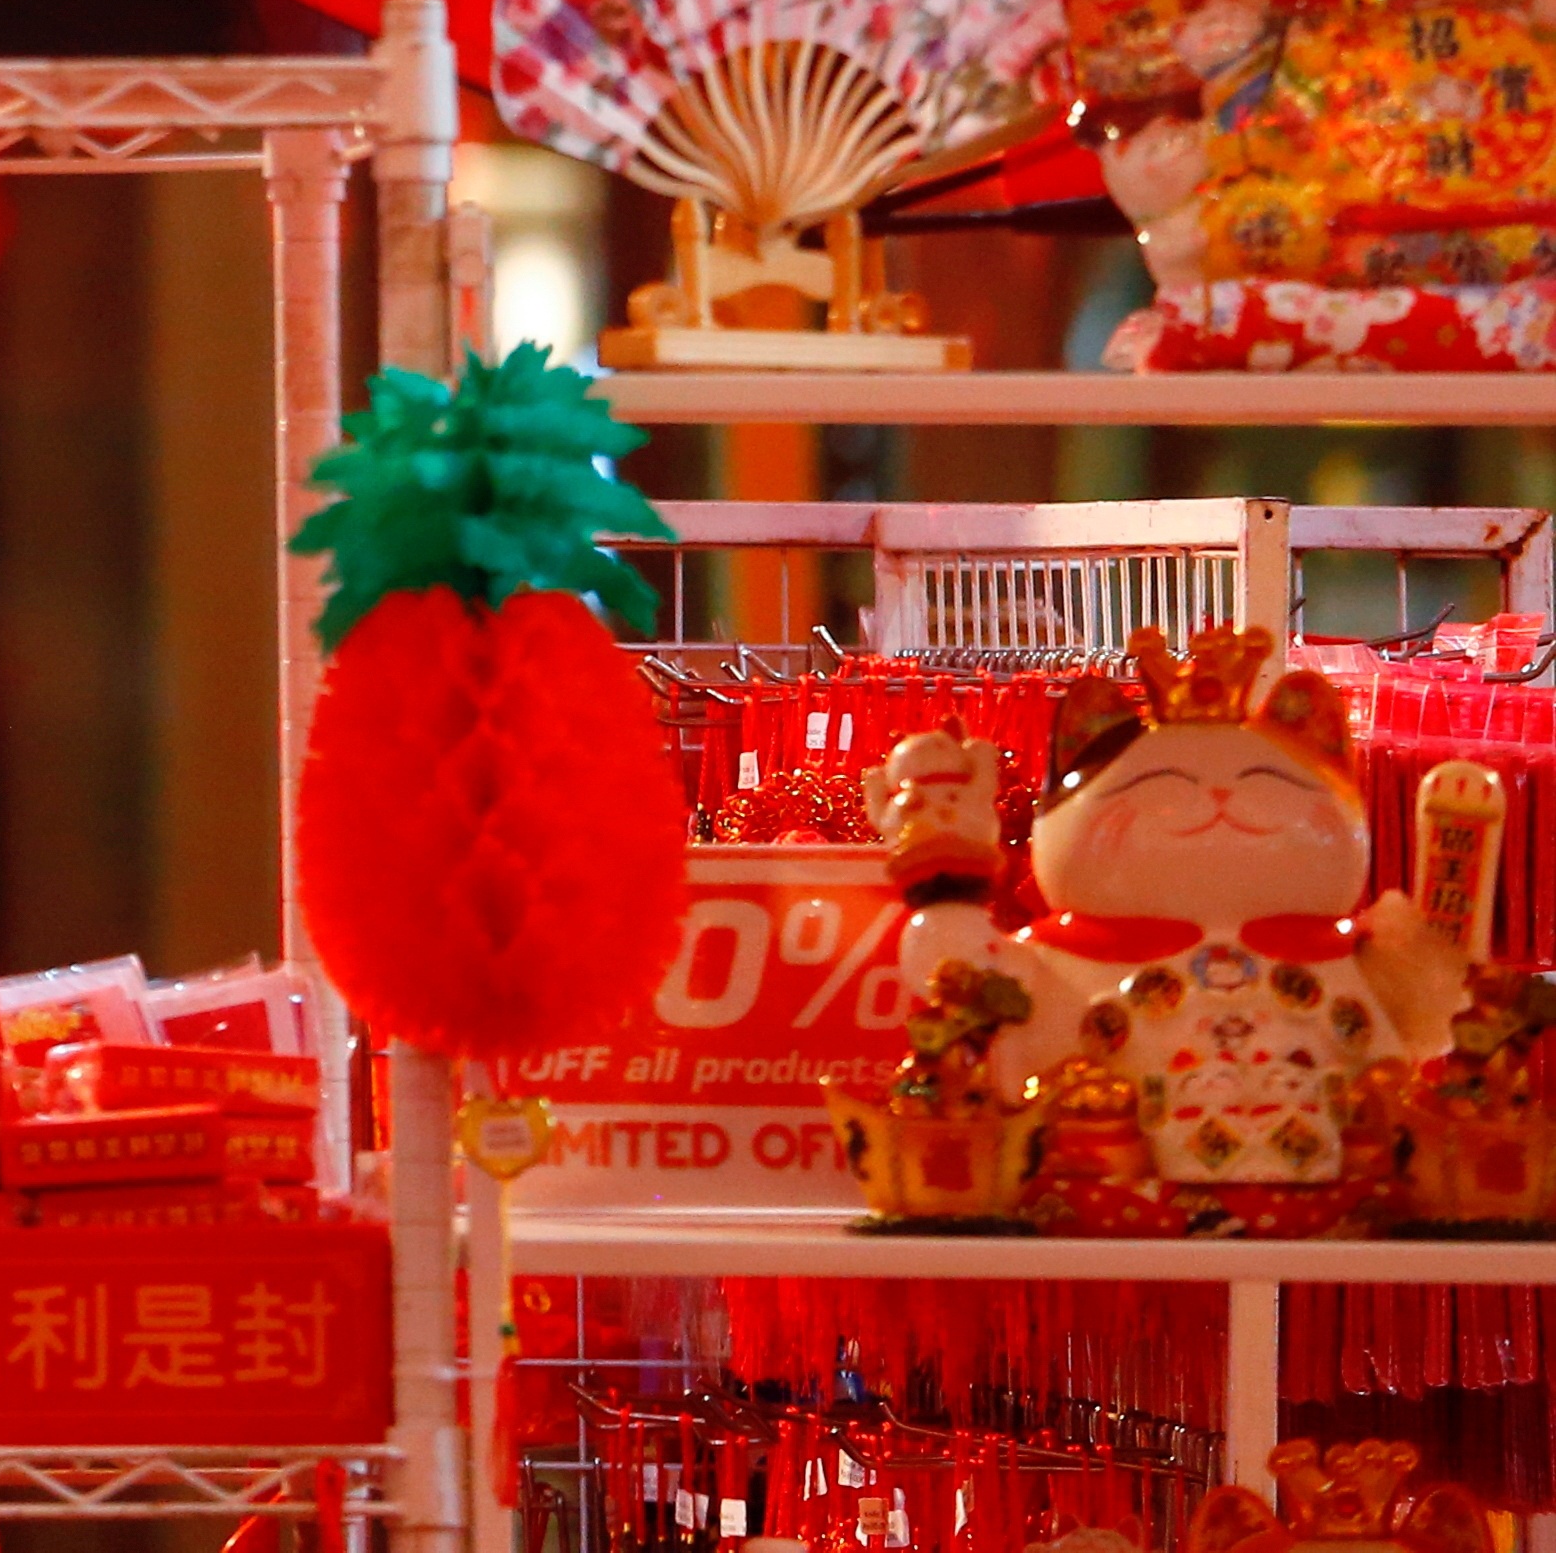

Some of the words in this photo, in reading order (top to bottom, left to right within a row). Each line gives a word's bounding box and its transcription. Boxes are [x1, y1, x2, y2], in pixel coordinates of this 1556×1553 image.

[654, 898, 912, 1031] 0%
[624, 1047, 681, 1083] all
[540, 1121, 731, 1169] MITED
